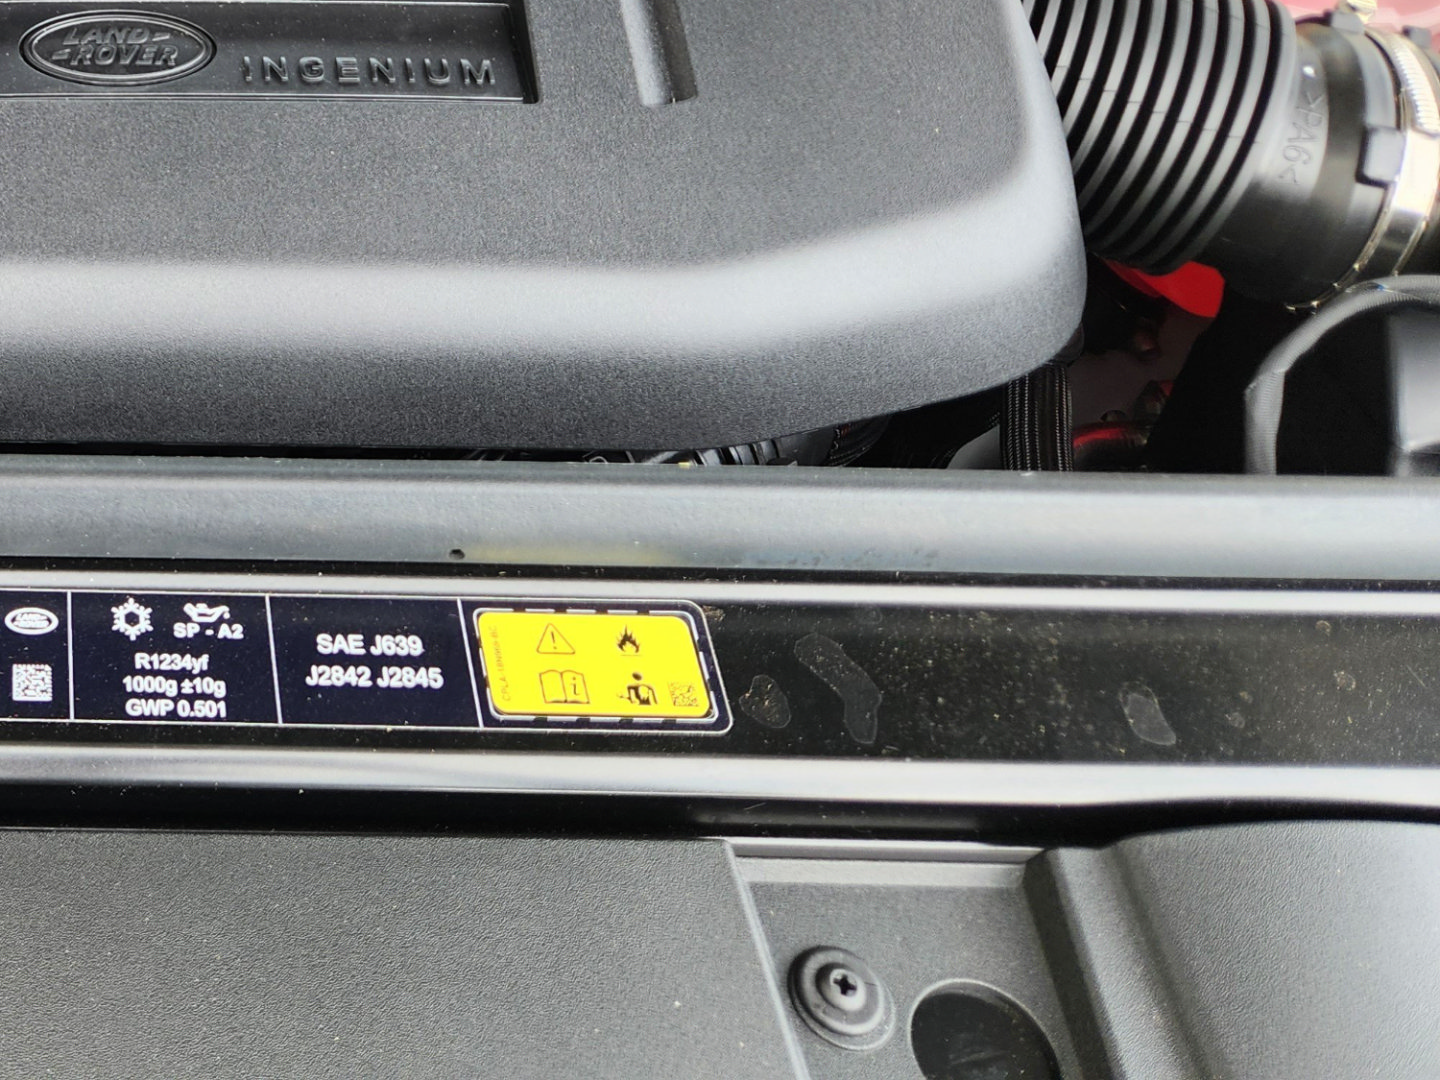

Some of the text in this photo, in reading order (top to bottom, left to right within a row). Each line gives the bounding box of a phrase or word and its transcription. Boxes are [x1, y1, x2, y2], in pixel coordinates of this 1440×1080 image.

[62, 25, 151, 46] LAND
[70, 44, 180, 67] ROVER
[242, 54, 498, 88] INGENIUM
[173, 623, 198, 639] SP
[217, 623, 244, 640] A2
[316, 634, 424, 657] SAE J639
[134, 652, 210, 674] R1234yf
[122, 675, 227, 698] 1000g ±10g
[305, 665, 445, 689] J2842 J2845
[125, 699, 227, 718] GWP 0.501
